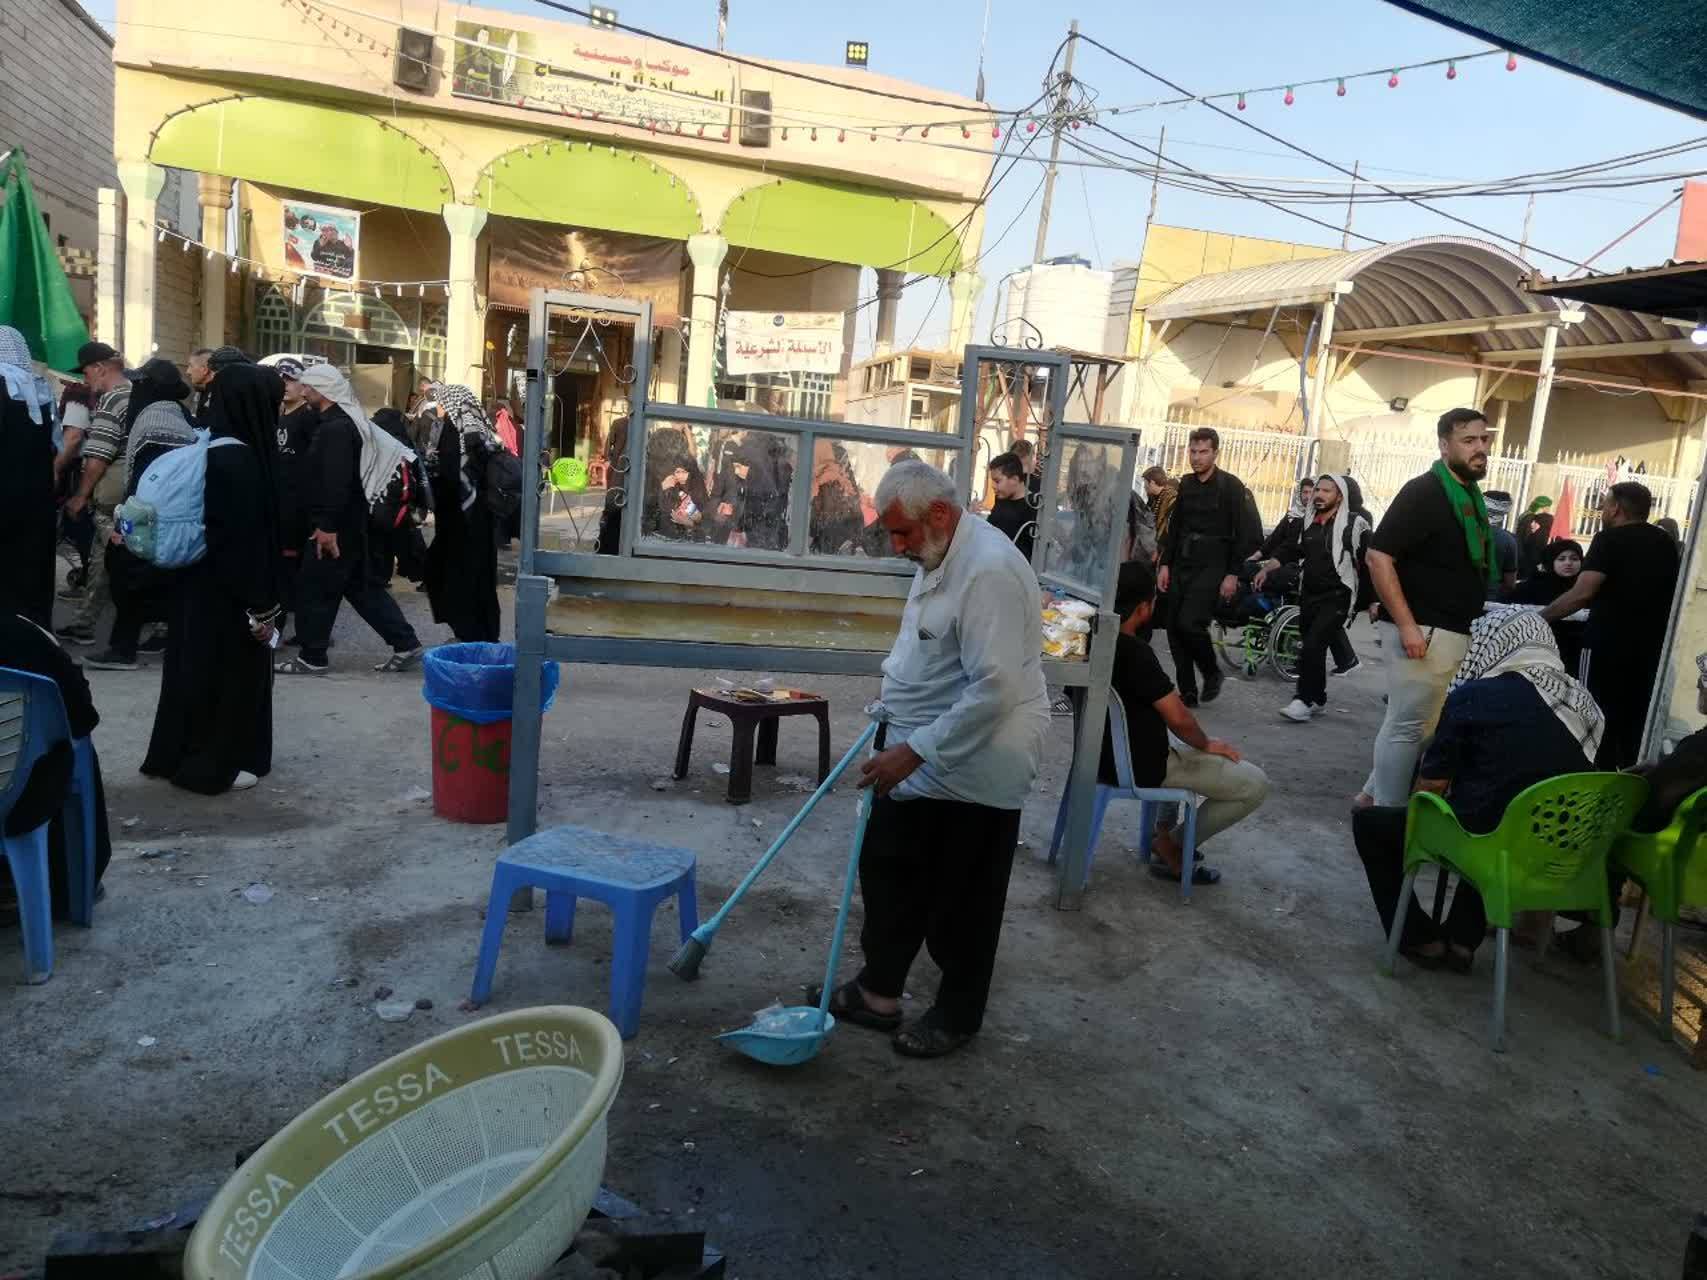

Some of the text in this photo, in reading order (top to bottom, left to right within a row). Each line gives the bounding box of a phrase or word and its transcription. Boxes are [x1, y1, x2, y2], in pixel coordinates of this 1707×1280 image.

[491, 1030, 585, 1067] TESSA
[322, 1061, 454, 1146] TESSA
[218, 1170, 297, 1270] TESSA
